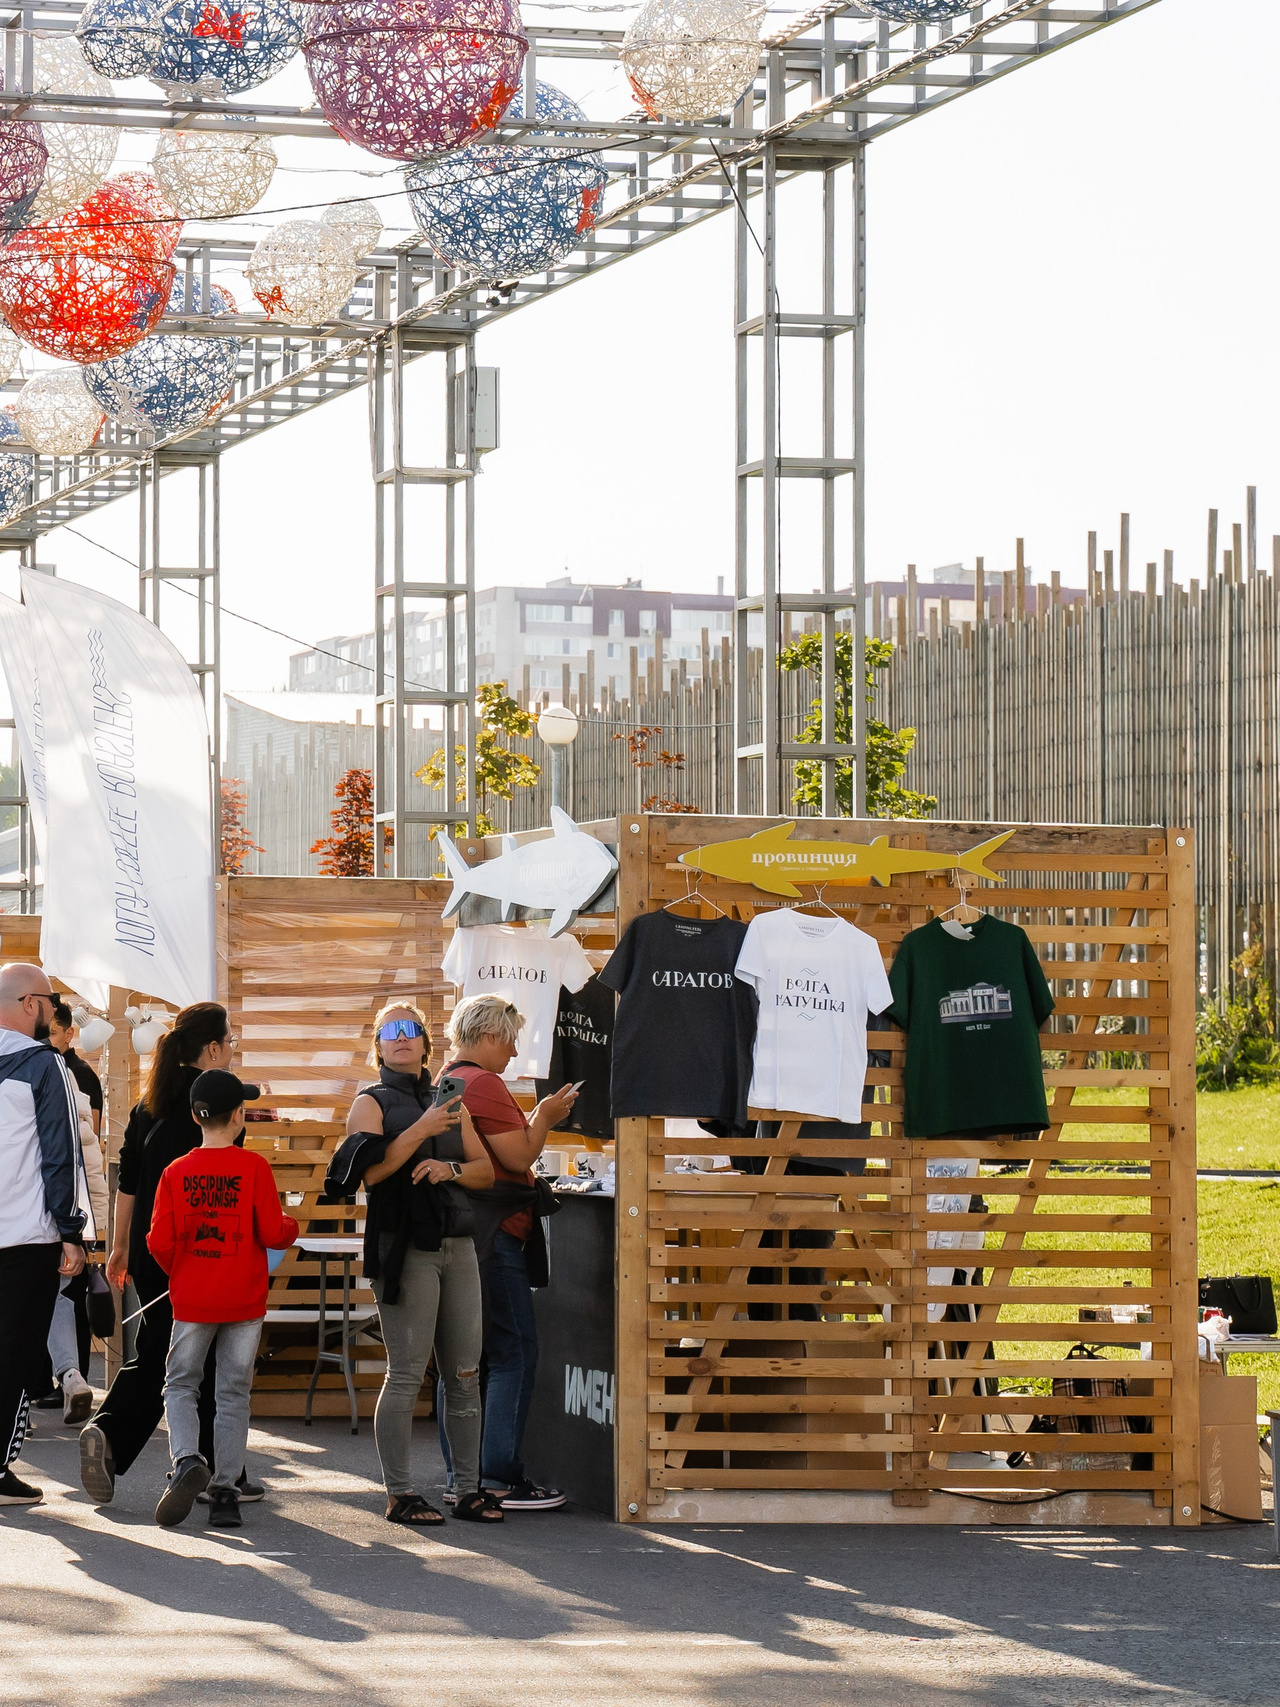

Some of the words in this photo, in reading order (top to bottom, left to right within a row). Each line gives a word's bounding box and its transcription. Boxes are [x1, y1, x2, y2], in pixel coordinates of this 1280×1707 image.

[751, 852, 857, 867] провинция
[478, 966, 548, 983] САРАТОВ
[652, 971, 733, 988] САРАТОВ
[786, 978, 830, 994] ВОЛГА
[560, 1011, 593, 1028] ВОЛГА
[183, 1175, 242, 1192] DISCIPLINE
